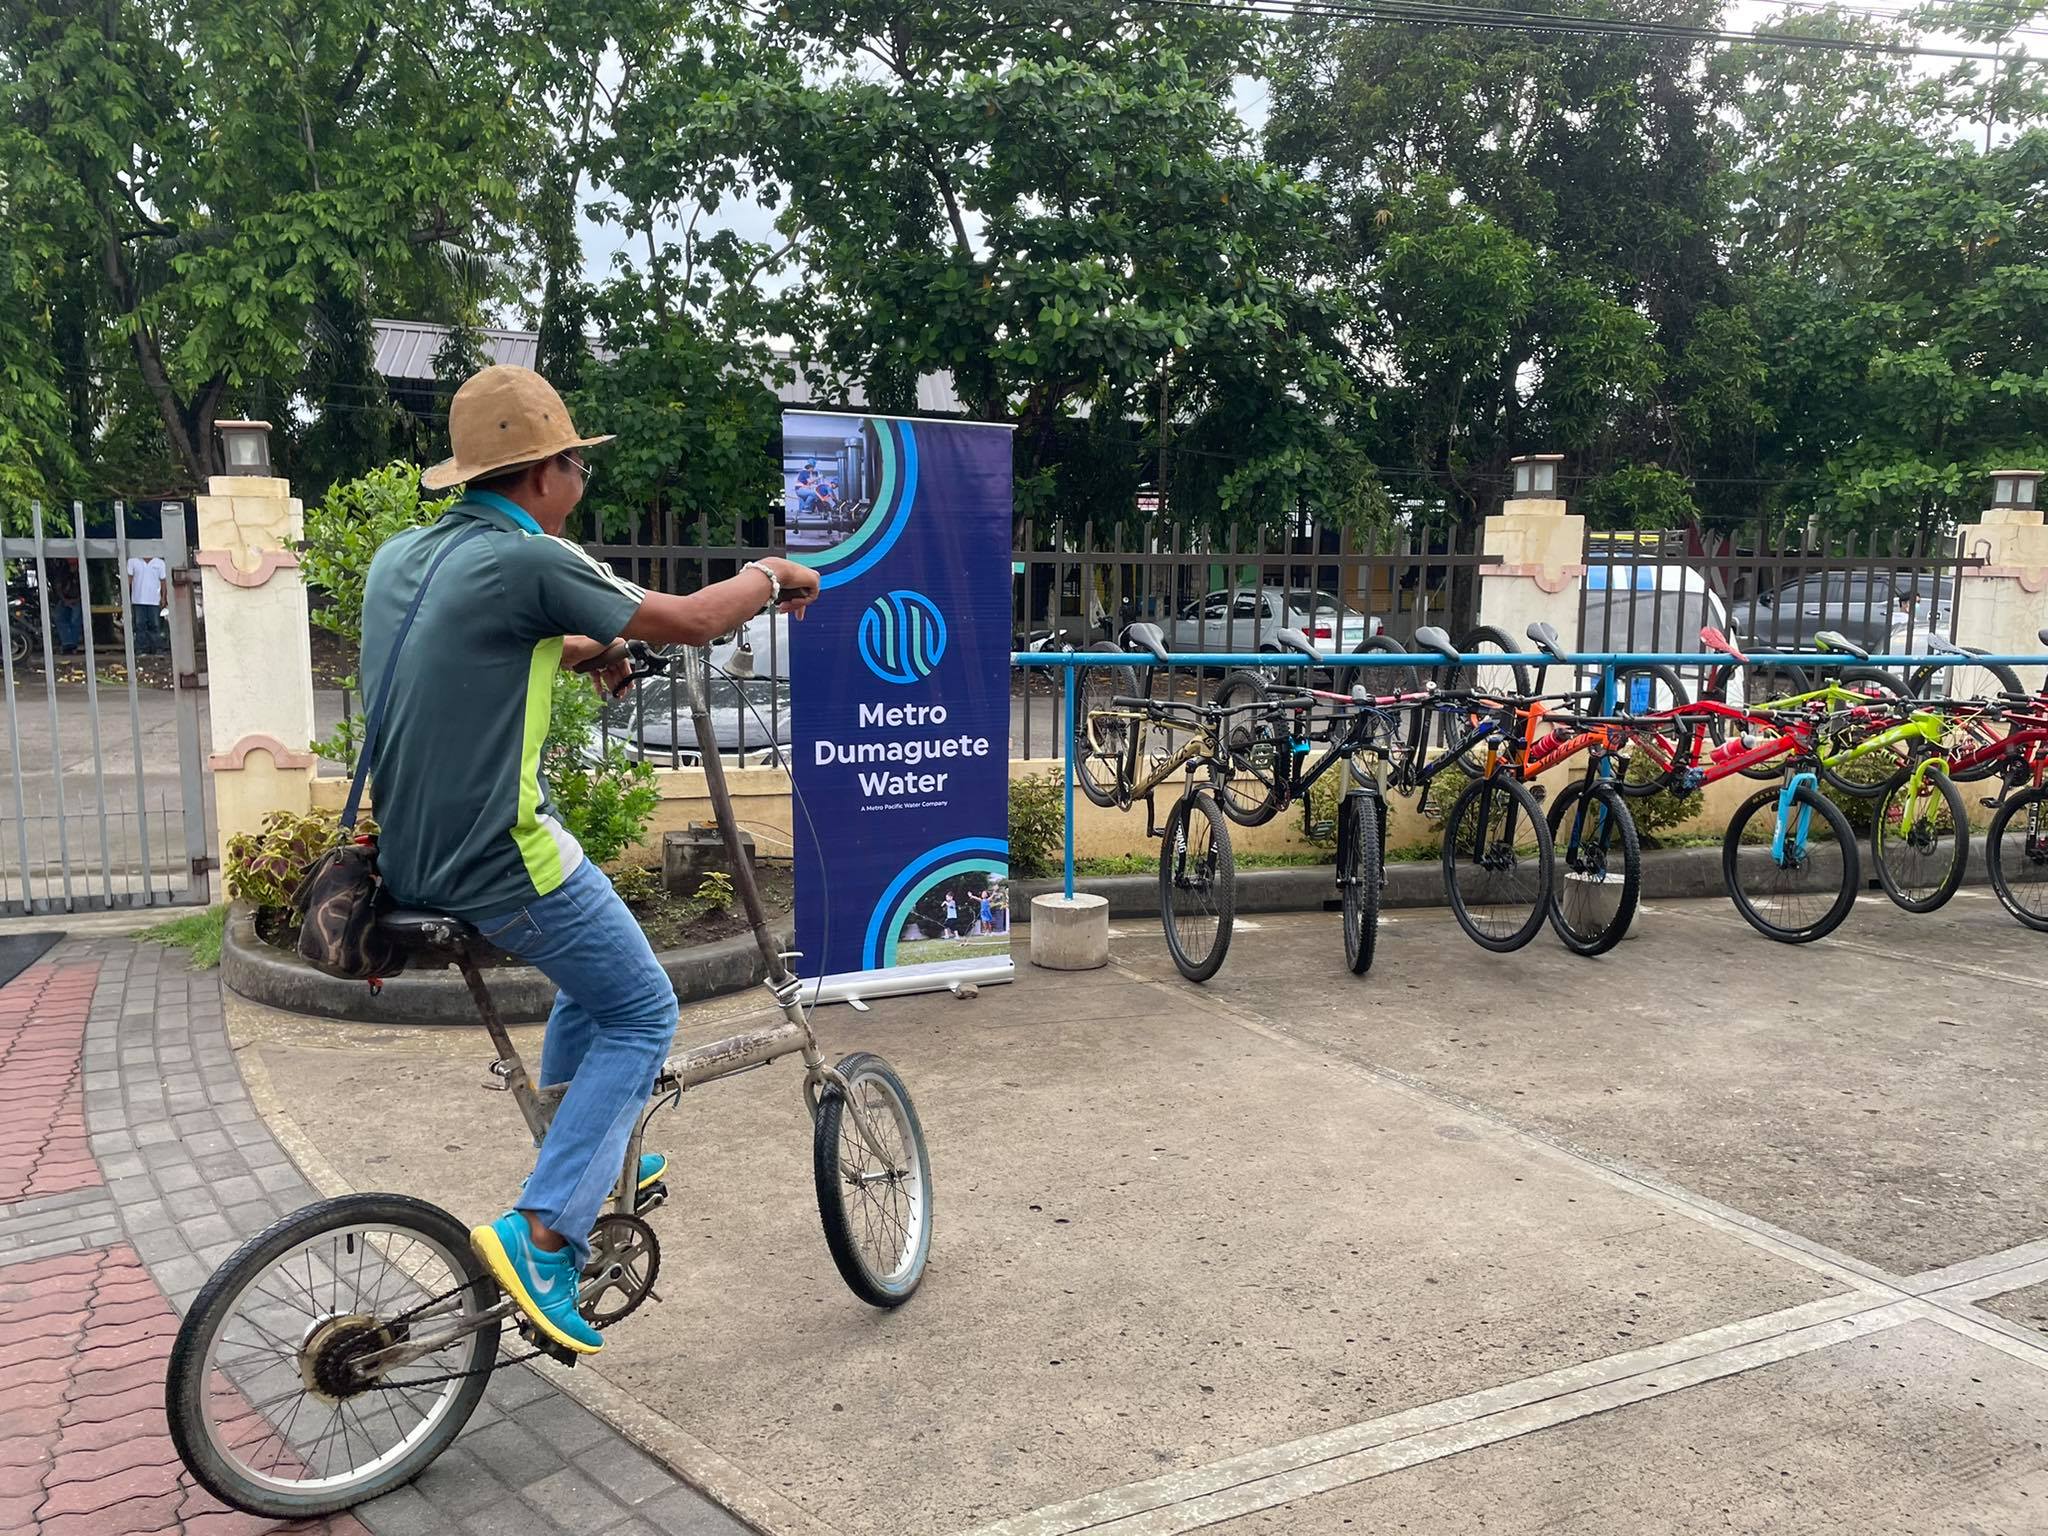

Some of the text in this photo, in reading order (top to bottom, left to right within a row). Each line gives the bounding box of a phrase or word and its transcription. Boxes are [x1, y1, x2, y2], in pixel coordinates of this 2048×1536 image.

[858, 702, 947, 728] Metro
[815, 734, 990, 766] Dumaguete
[857, 771, 949, 797] Water
